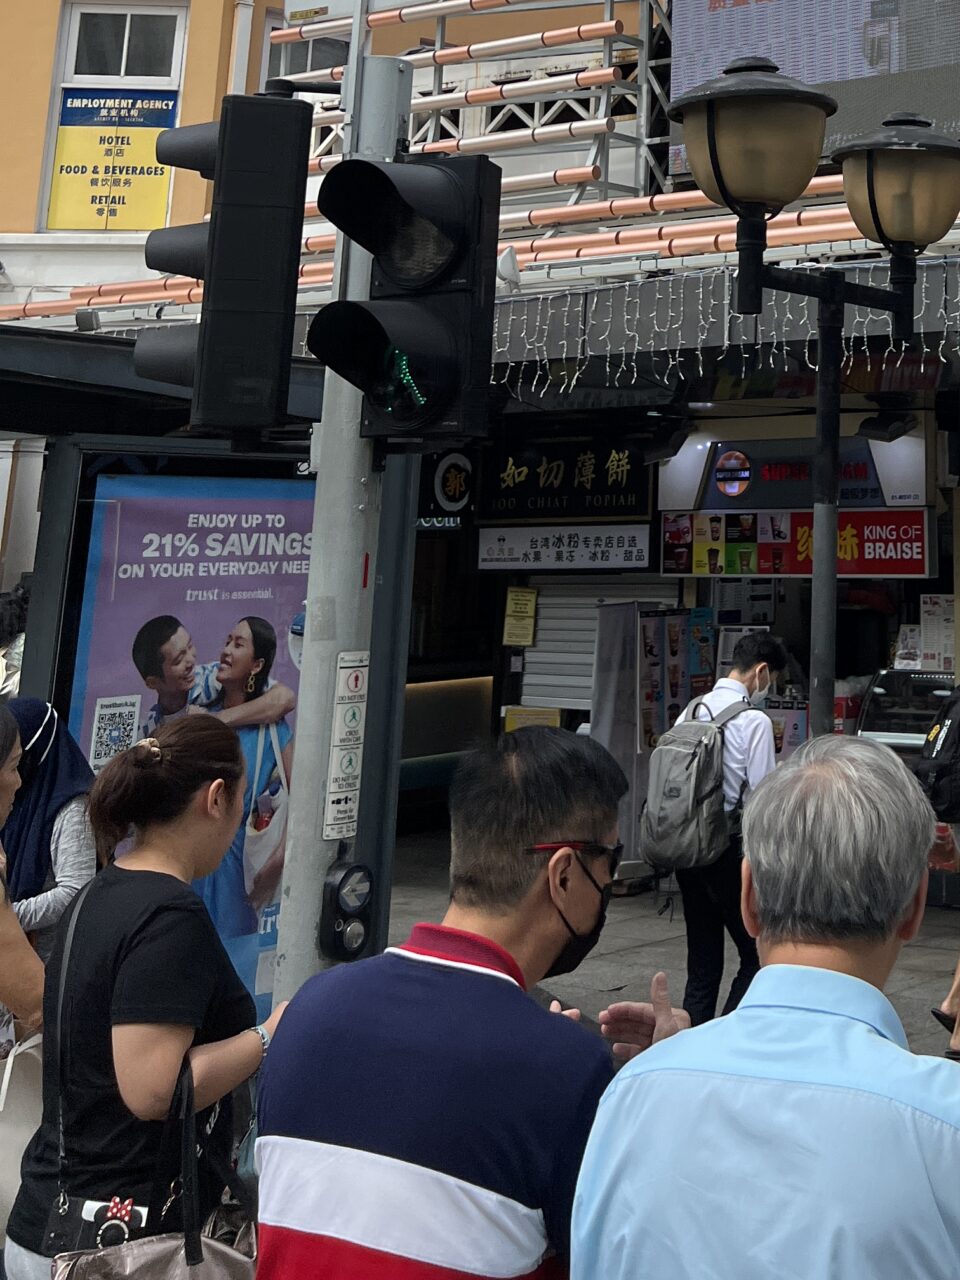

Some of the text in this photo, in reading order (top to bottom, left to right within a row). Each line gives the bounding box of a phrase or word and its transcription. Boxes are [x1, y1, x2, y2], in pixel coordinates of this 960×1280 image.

[67, 98, 175, 110] EMPLOYMENT AGENCY
[99, 136, 131, 146] HOTEL
[104, 148, 125, 157] 酒店
[60, 164, 165, 176] FOOD & BEVERAGES
[90, 195, 126, 205] RETAIL
[527, 495, 569, 510] CHIAT
[187, 513, 285, 528] ENJOY UP TO
[863, 524, 921, 540] KING OF
[142, 532, 313, 558] 21% SAVINGS
[864, 542, 922, 560] BRAISE
[118, 560, 310, 578] ON YOUR EVERYDAY NEE
[185, 588, 274, 602] trust is essential.
